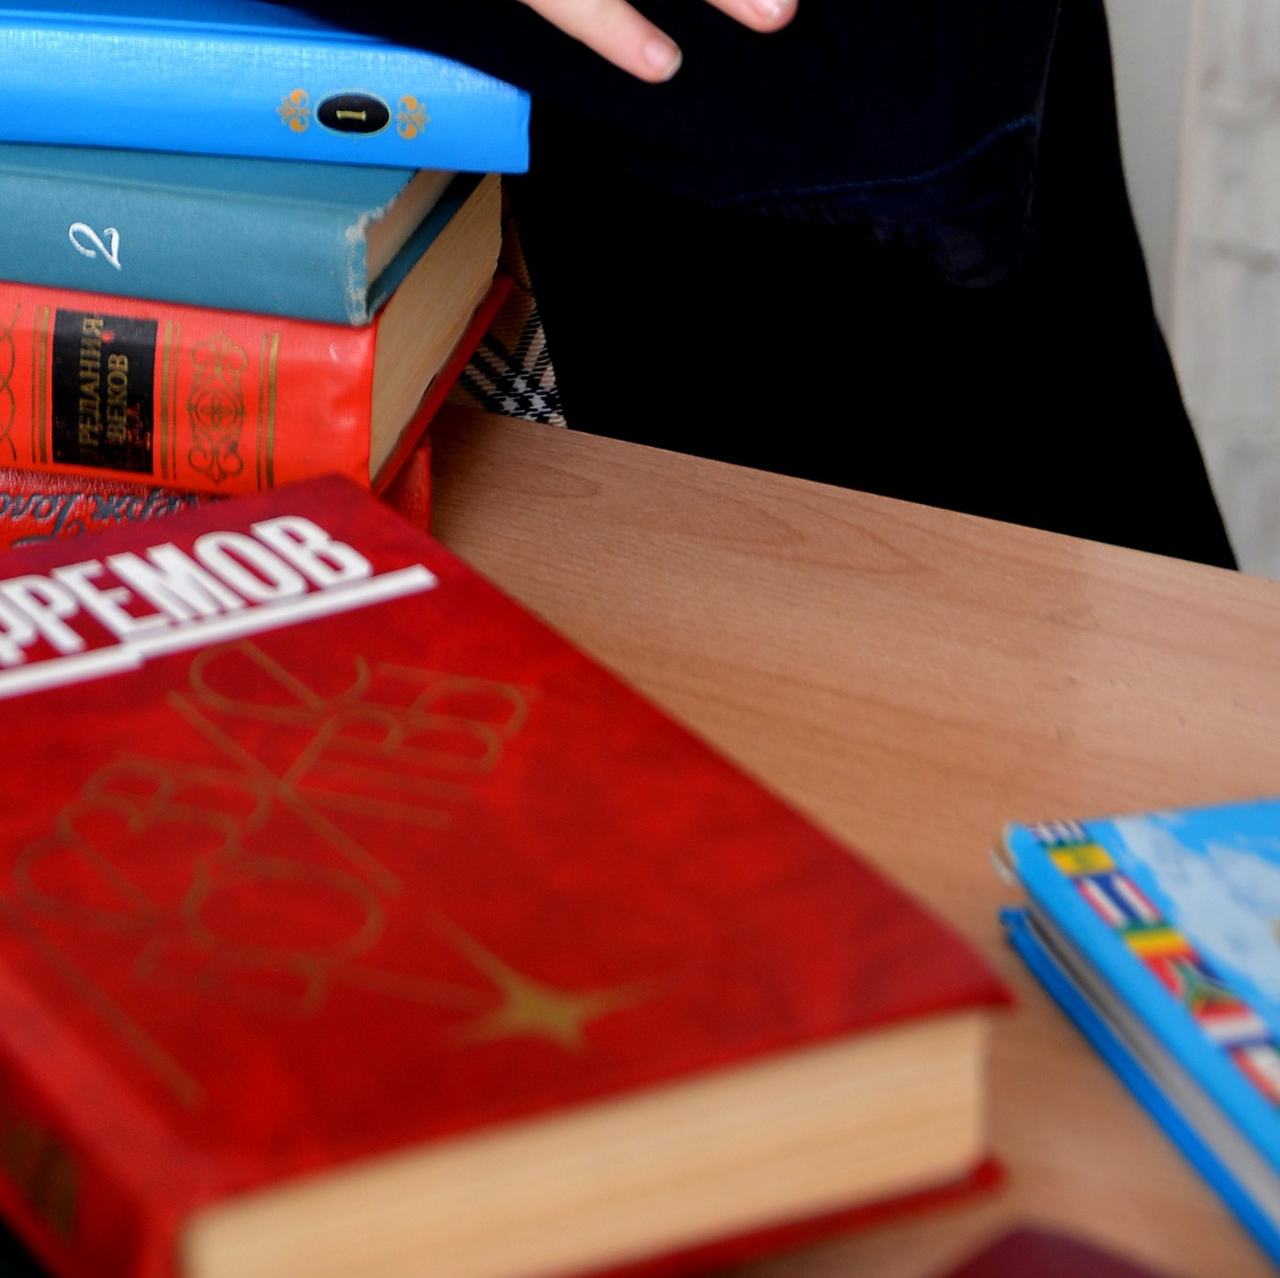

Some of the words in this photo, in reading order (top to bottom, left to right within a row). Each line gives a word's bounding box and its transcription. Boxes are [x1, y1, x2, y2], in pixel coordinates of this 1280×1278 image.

[68, 221, 121, 270] 2
[78, 316, 103, 453] РЕДАНИЯ
[106, 352, 128, 441] ВЕКОВ
